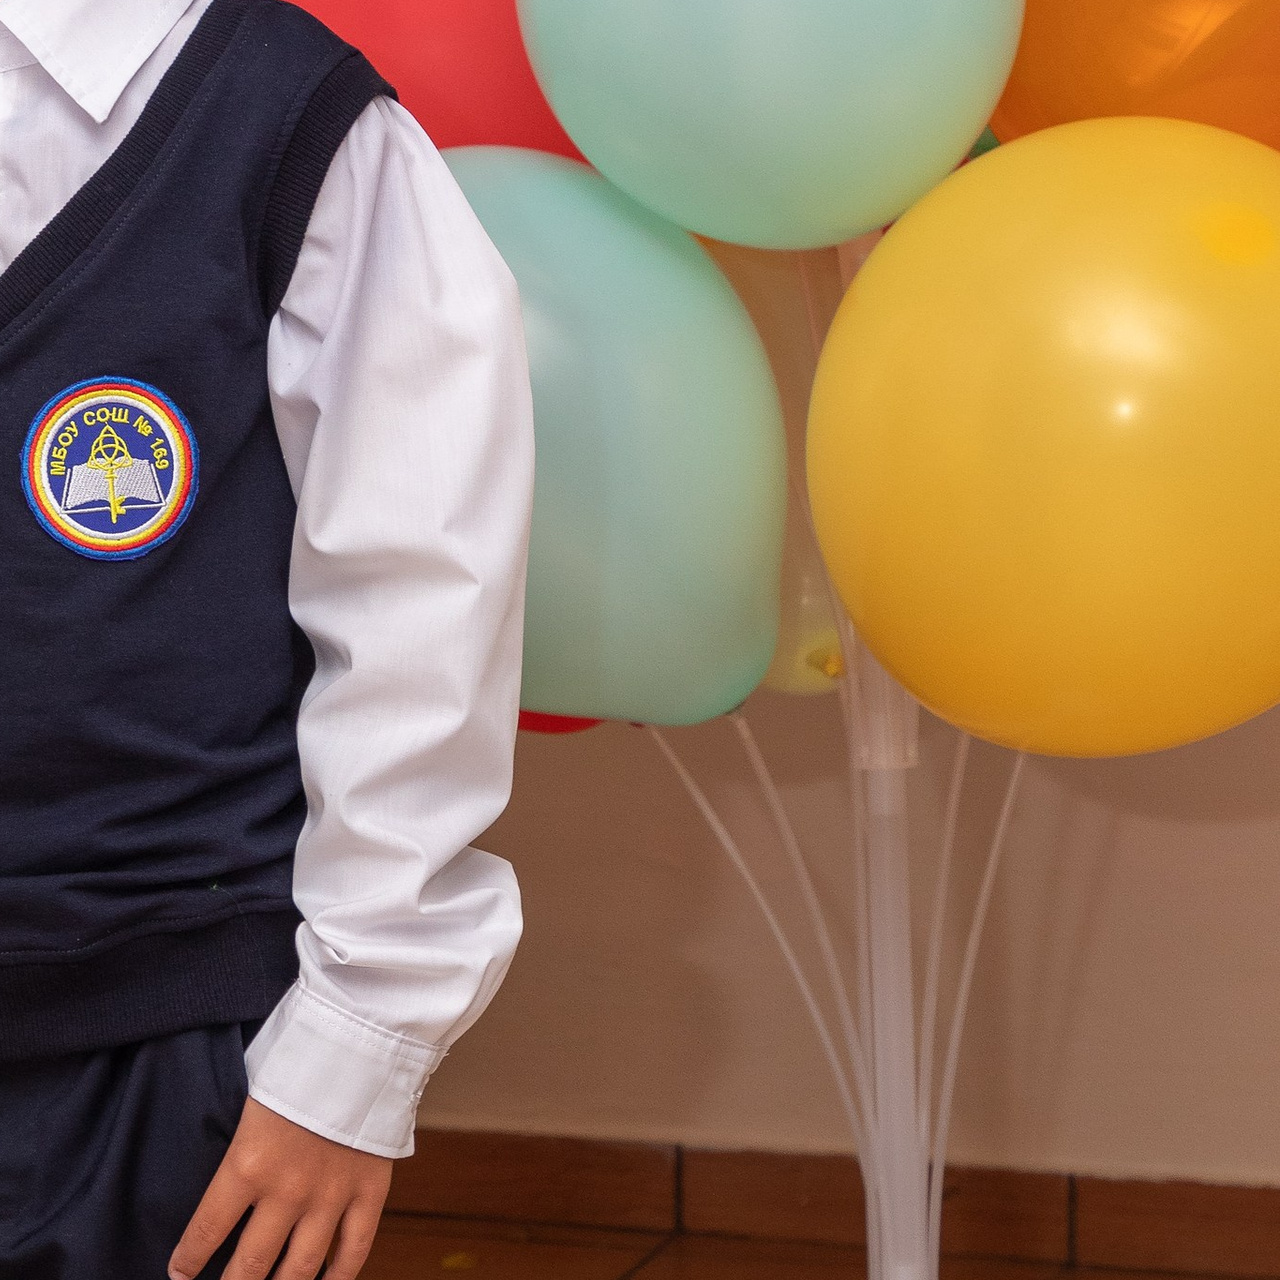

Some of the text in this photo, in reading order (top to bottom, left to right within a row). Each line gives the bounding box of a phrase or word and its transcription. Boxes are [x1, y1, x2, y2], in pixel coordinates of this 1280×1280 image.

[50, 407, 170, 476] МБОУ СОШ № 169
